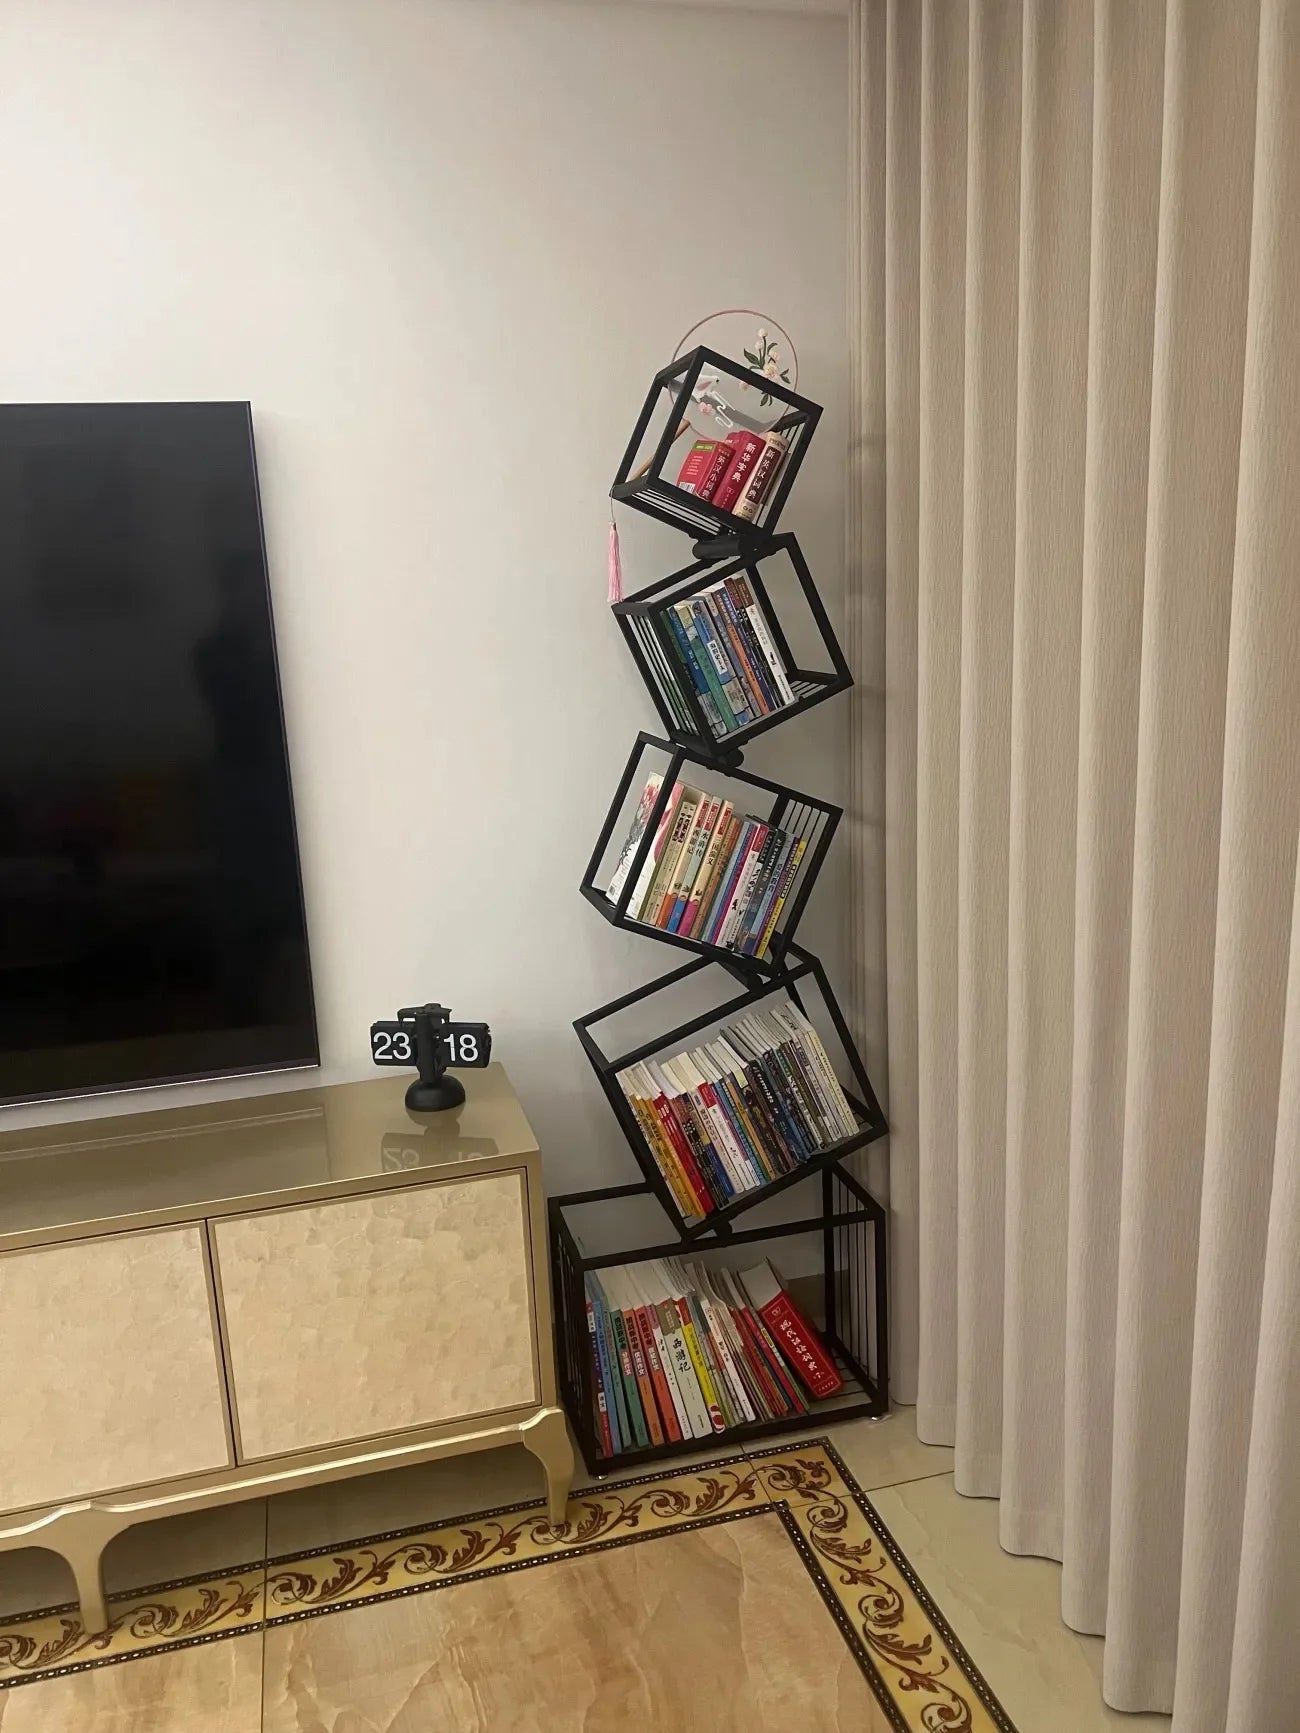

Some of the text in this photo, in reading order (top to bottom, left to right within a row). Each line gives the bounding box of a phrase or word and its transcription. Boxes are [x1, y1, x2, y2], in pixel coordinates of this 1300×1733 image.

[731, 442, 756, 482] 新华字典
[686, 828, 700, 854] 西游记
[694, 831, 709, 857] 水浒传
[705, 836, 722, 865] 三国演义
[373, 1032, 479, 1062] 23 18
[671, 1337, 691, 1372] 西游记
